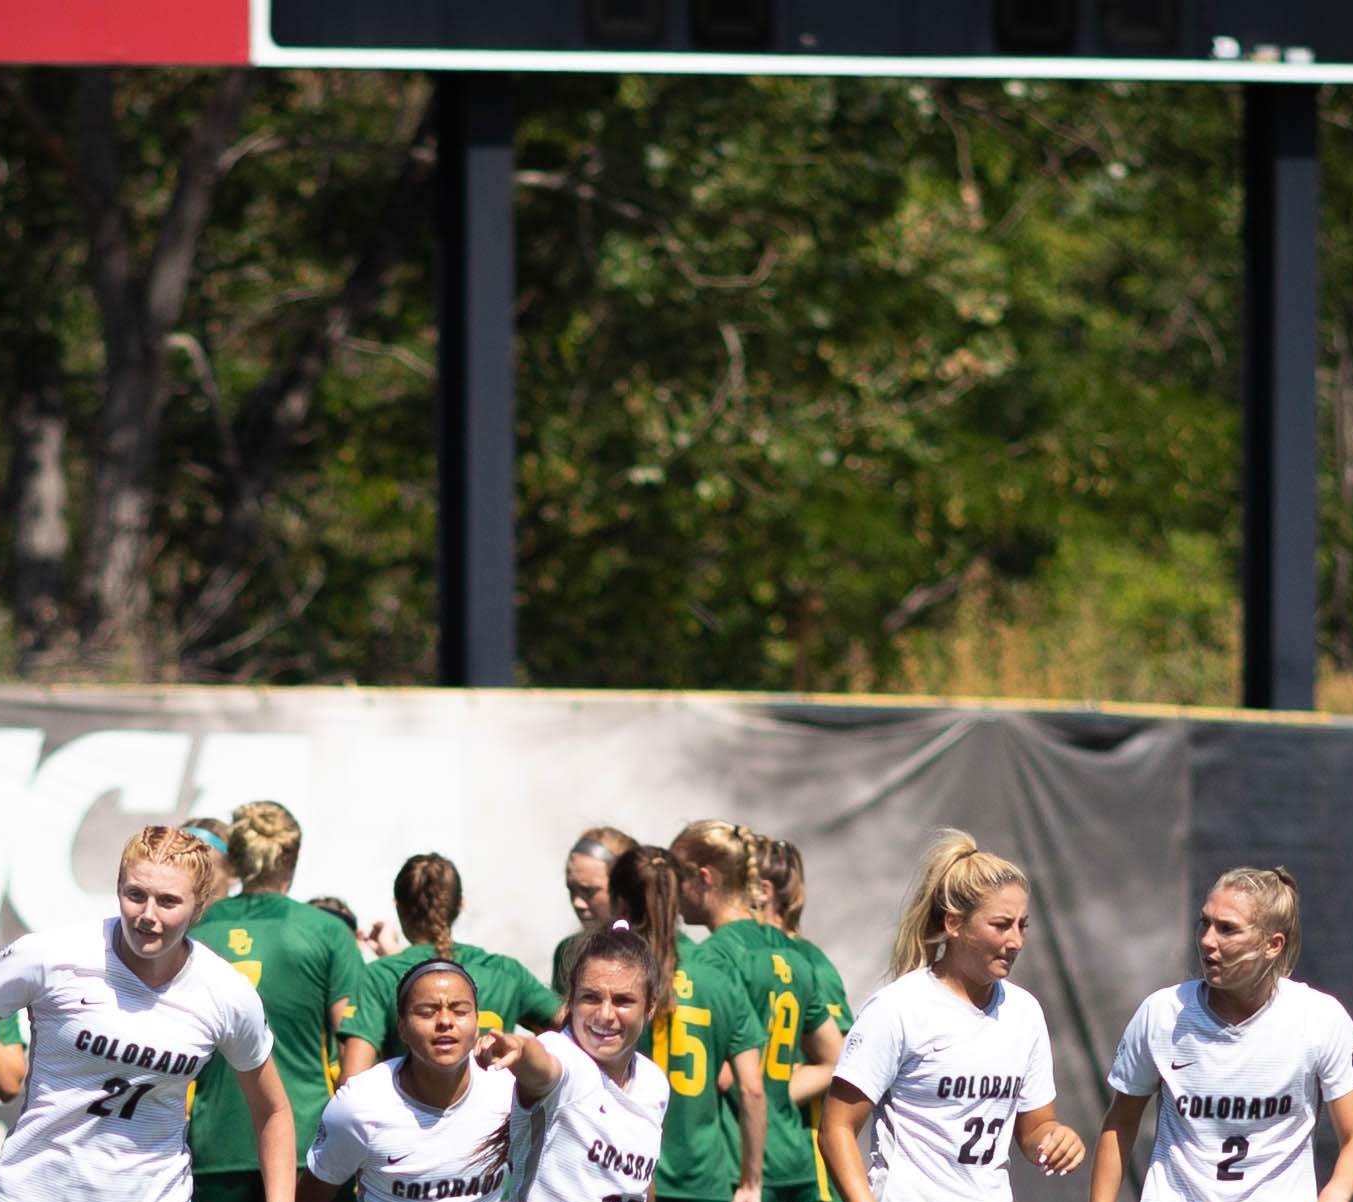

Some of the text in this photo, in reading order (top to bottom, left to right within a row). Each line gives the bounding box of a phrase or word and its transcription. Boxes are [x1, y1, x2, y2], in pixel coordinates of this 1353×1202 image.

[75, 1029, 199, 1075] COLORADO
[86, 1077, 155, 1120] 21
[1176, 1094, 1292, 1119] COLORADO
[957, 1116, 1005, 1165] 23
[1216, 1135, 1249, 1181] 2
[391, 1168, 504, 1200] COLORADO
